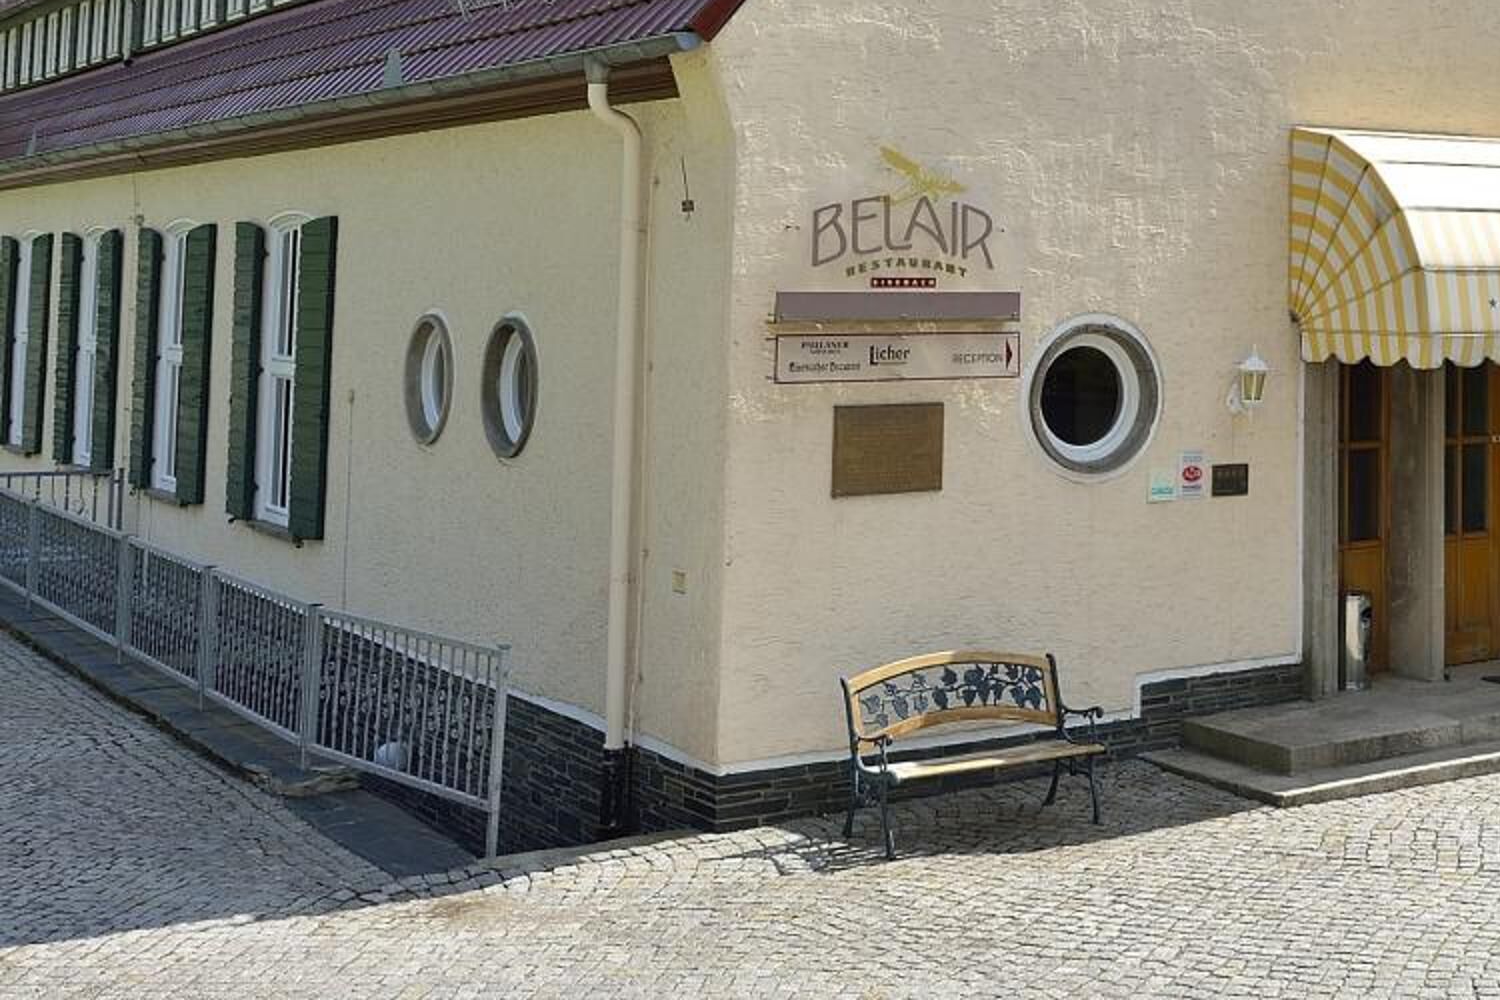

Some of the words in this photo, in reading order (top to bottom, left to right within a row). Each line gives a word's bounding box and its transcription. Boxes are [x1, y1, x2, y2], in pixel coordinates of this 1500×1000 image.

[812, 195, 994, 270] BELAIR
[846, 257, 968, 277] RESTAURANT
[869, 345, 910, 366] Licher
